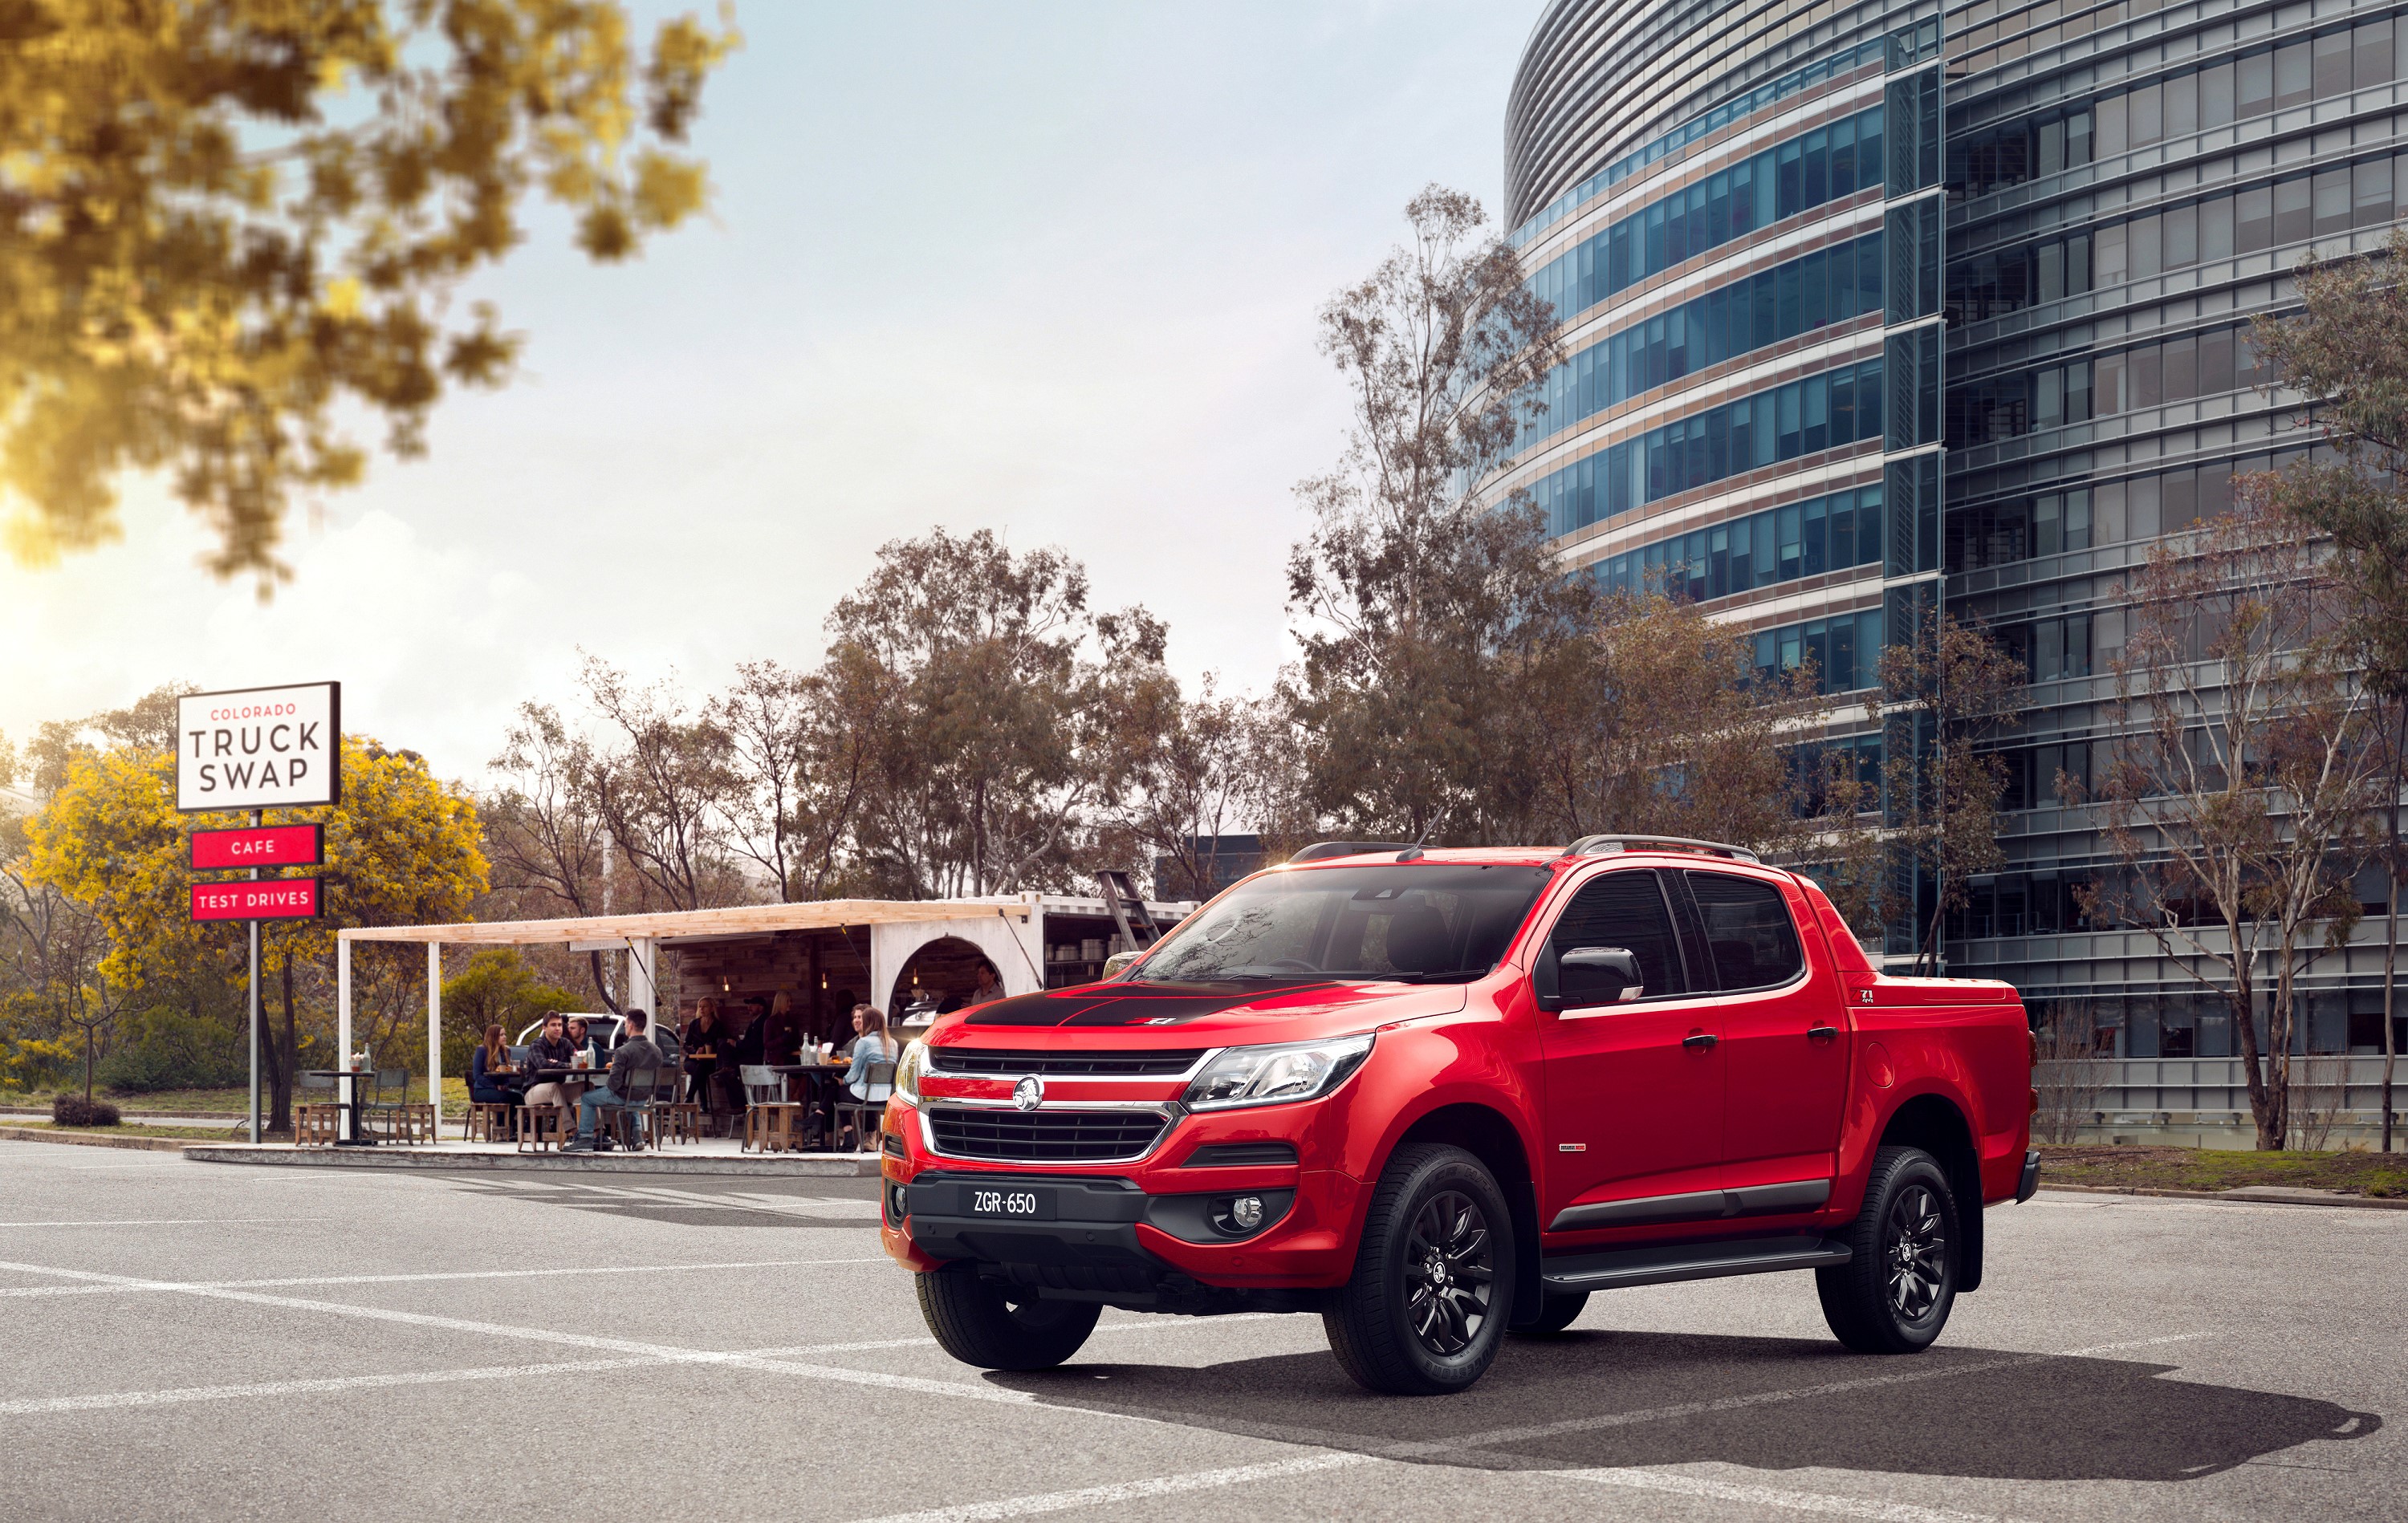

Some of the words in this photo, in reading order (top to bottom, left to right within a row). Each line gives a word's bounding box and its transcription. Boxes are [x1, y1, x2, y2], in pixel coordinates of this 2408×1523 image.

[210, 703, 296, 721] COLORADO
[189, 721, 319, 758] TRUCK
[200, 758, 307, 792] SWAP
[231, 840, 275, 855] CAFE
[199, 895, 238, 908] TEST
[247, 891, 308, 907] DRIVES
[974, 1191, 1036, 1214] ZGR-650
